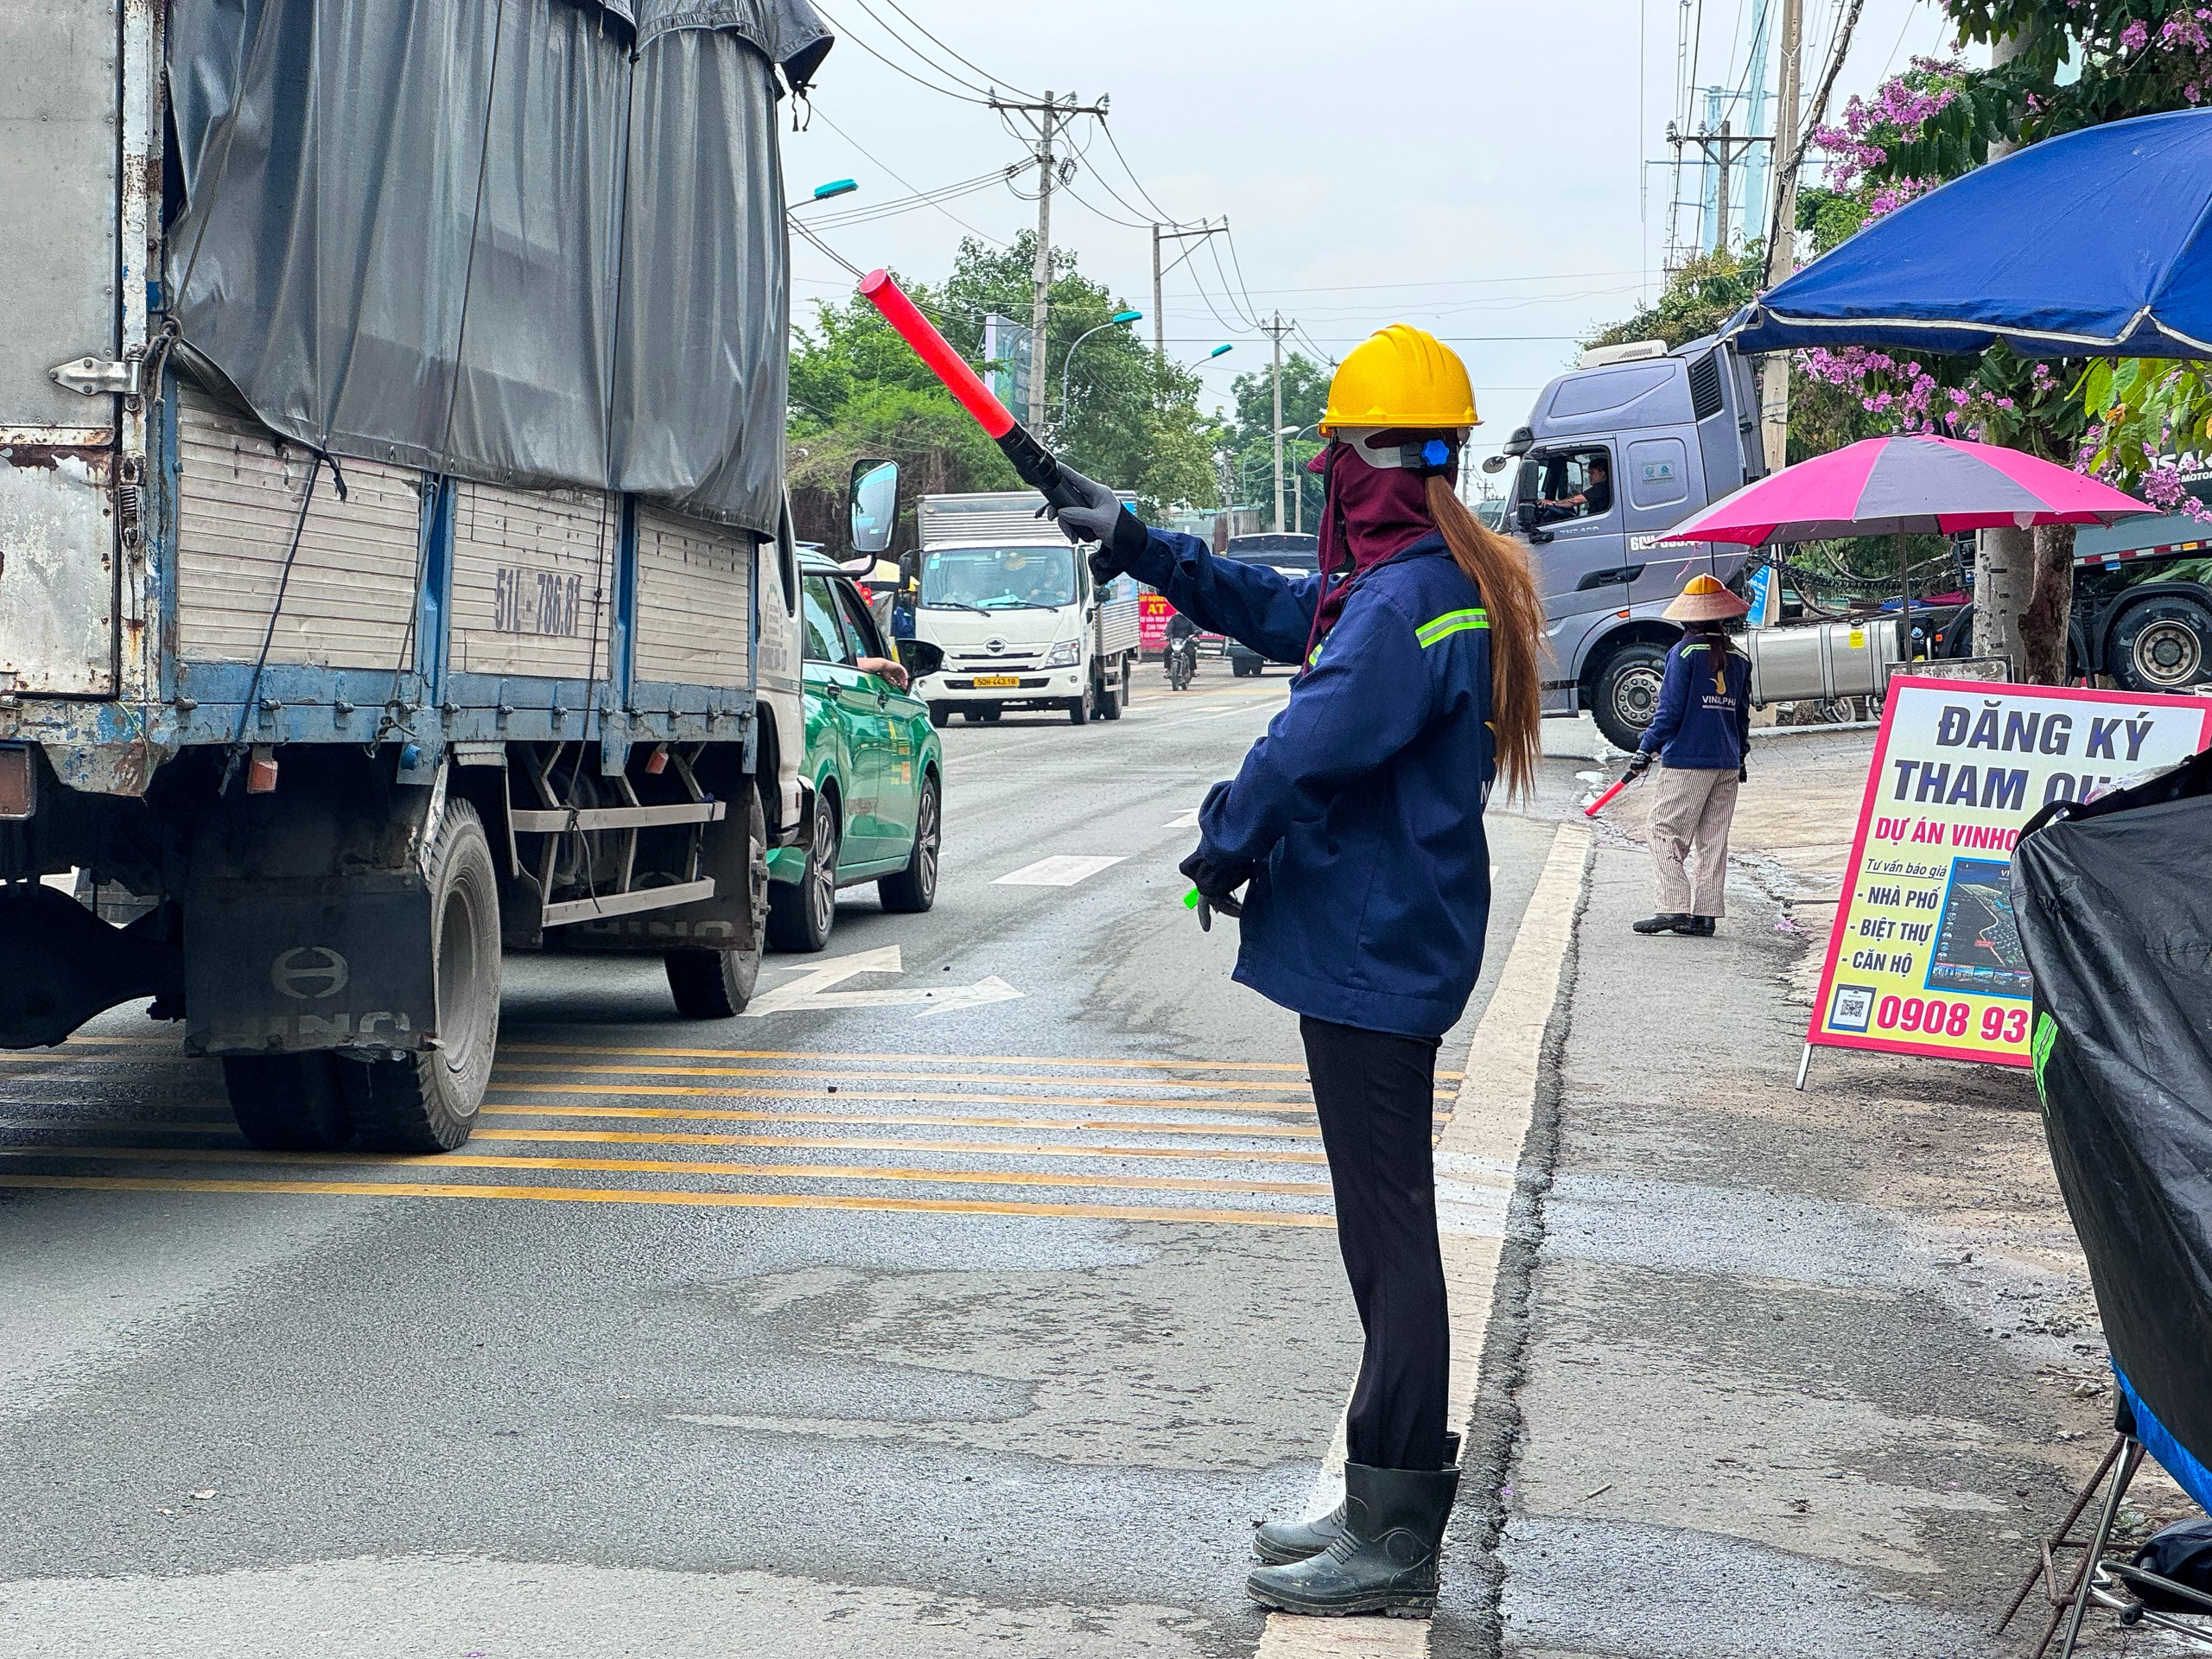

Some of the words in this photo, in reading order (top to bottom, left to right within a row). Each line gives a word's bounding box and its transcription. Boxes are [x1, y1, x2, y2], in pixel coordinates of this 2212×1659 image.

[1936, 700, 2073, 756] ĐĂNG
[2085, 711, 2155, 761] KÝ
[1893, 759, 2030, 810] THAM
[1875, 817, 1911, 846] DỰ
[1910, 817, 1945, 845] ÁN
[1867, 858, 1883, 871] Tư
[1884, 859, 1904, 873] vấn
[1905, 862, 1927, 875] báo
[1928, 865, 1948, 879] giá
[1867, 885, 1901, 906] NHÀ
[1904, 887, 1942, 910] PHỐ
[1859, 917, 1897, 942] BIỆT
[1900, 923, 1934, 946] THỰ
[1852, 948, 1887, 971] CĂN
[1890, 952, 1913, 977] HỘ
[1877, 995, 1971, 1037] 0908
[1980, 1006, 2029, 1044] 93
